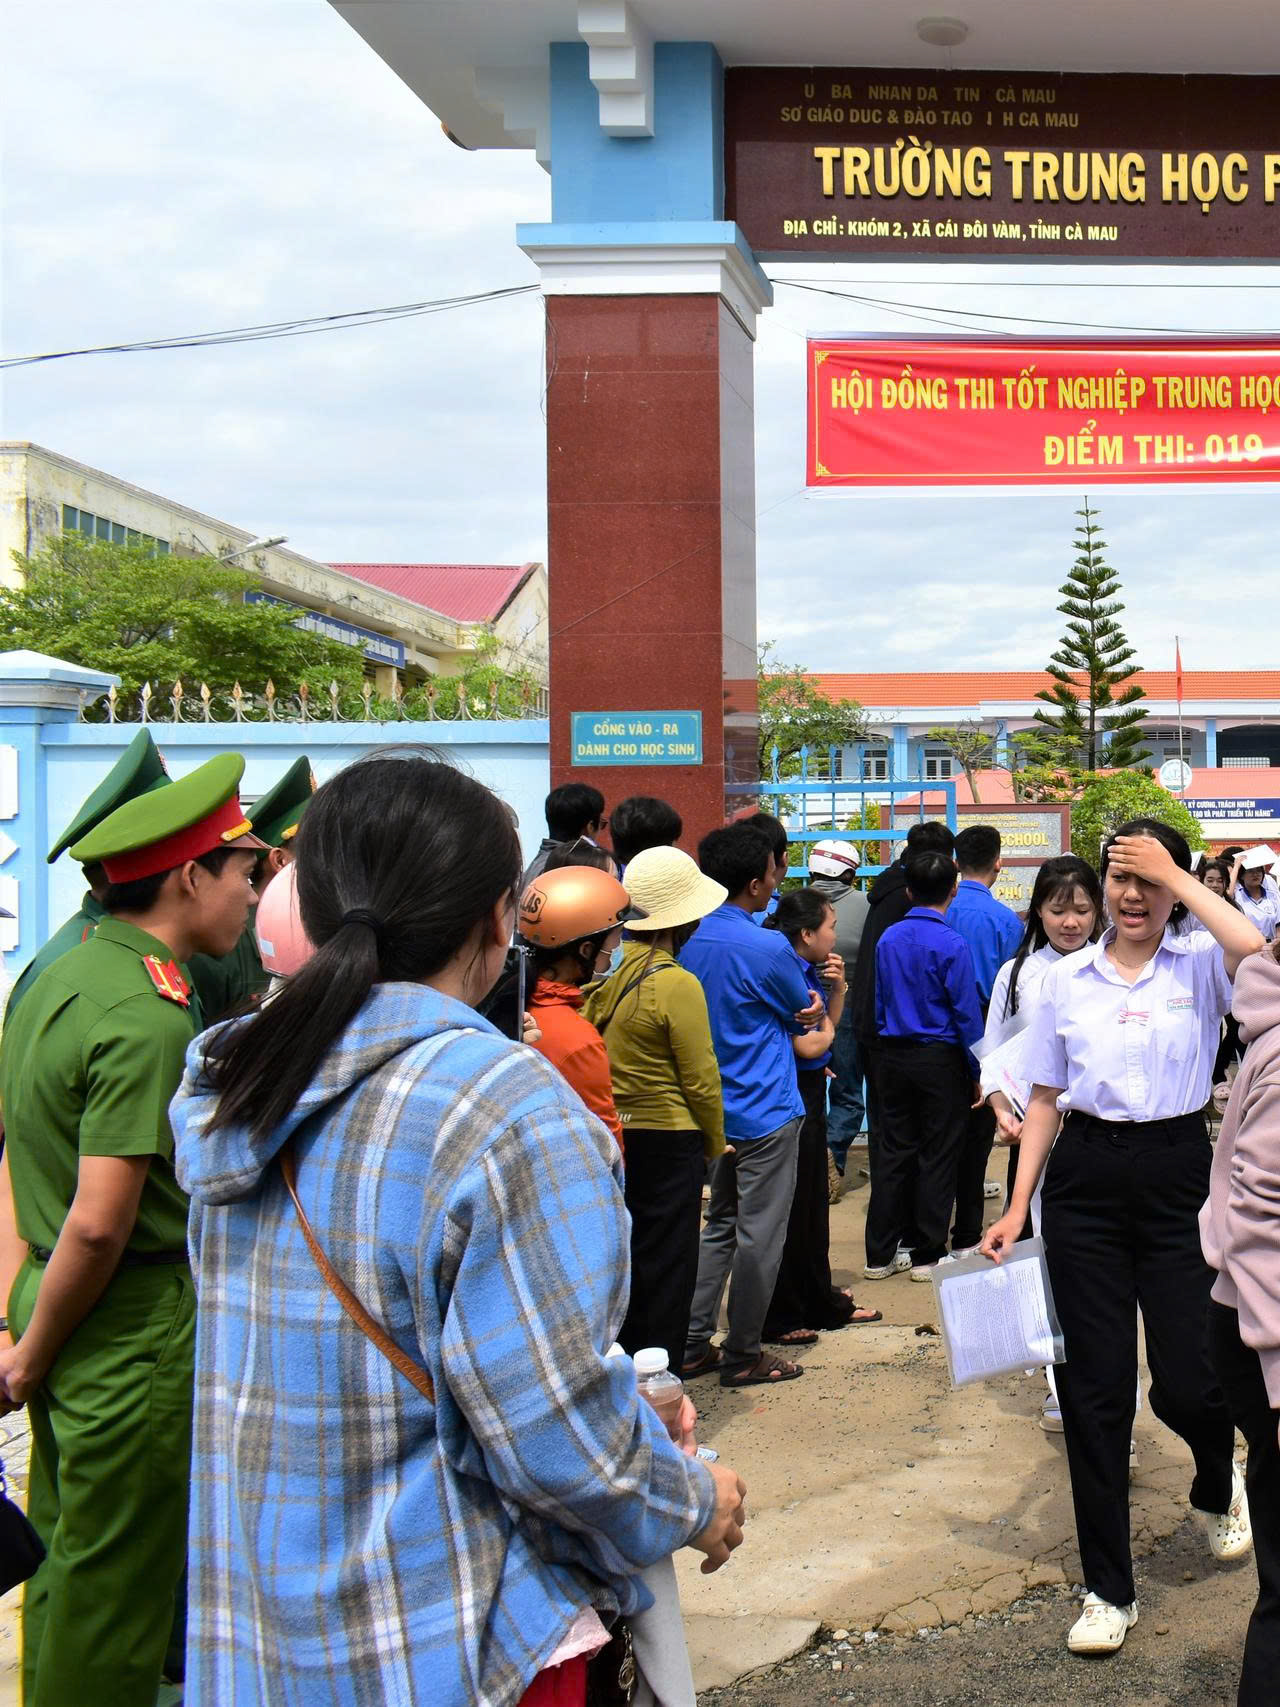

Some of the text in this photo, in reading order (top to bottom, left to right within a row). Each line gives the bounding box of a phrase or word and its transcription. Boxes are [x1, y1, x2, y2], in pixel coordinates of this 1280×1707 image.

[996, 85, 1016, 103] CÀ
[1022, 89, 1056, 104] MAU
[807, 104, 844, 123] GIÁO
[887, 109, 898, 123] &
[904, 106, 937, 125] ĐÀO
[1045, 113, 1079, 128] MAU
[814, 136, 992, 199] TRƯỜNG
[1004, 150, 1146, 202] TRUNG
[1161, 152, 1249, 214] HỌC
[784, 219, 808, 238] ĐỊA
[848, 218, 890, 238] KHÓM
[912, 218, 931, 238] XÃ
[935, 219, 959, 238] CÁI
[963, 220, 988, 239] ĐÔI
[992, 220, 1028, 241] VÀM,
[1029, 218, 1061, 240] TỈNH
[1065, 220, 1084, 240] CÀ
[1088, 226, 1118, 241] MAU
[831, 369, 873, 415] HỘI
[881, 364, 948, 410] ĐỒNG
[954, 377, 995, 410] THI
[1002, 365, 1049, 410] TỐT
[1057, 368, 1147, 416] NGHIỆP
[1151, 375, 1232, 410] TRUNG
[1043, 420, 1125, 466] ĐIỂM
[1133, 434, 1195, 466] THI:
[1204, 433, 1264, 464] 019
[593, 717, 625, 736] CỔNG
[628, 721, 652, 736] VÀO
[663, 723, 679, 736] RA
[577, 740, 695, 758] DÀNH CHO HỌC SINH
[1000, 832, 1049, 848] SCHOOL
